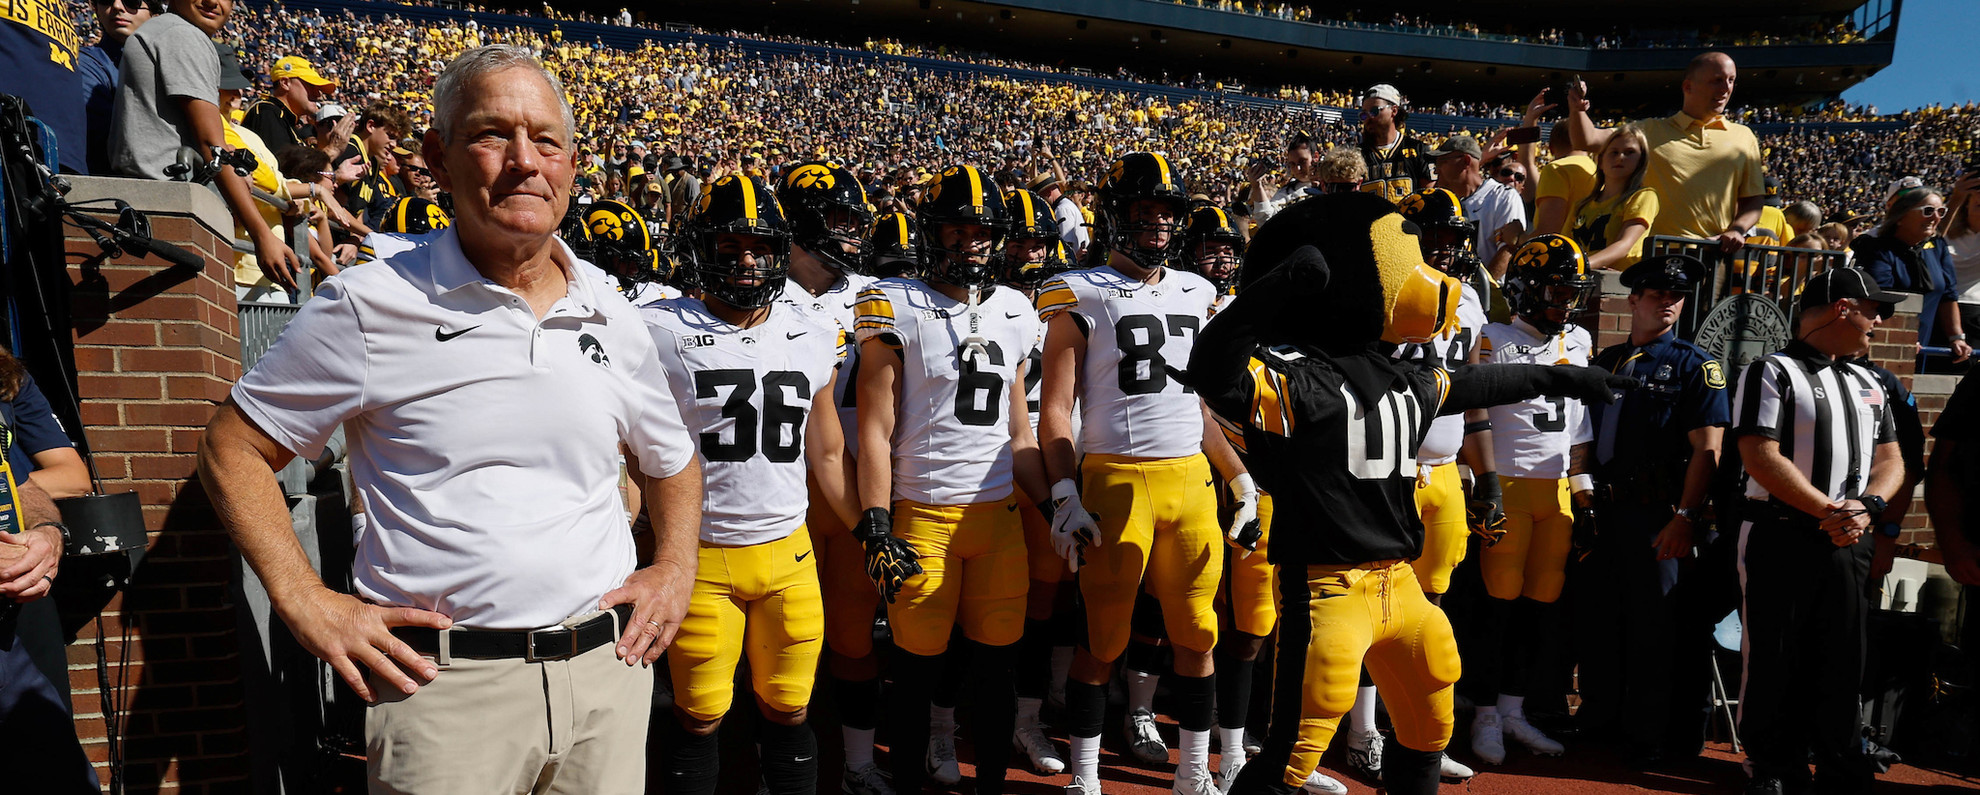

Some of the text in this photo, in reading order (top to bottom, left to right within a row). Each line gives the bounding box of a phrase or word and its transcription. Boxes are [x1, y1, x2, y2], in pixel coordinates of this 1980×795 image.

[36, 5, 79, 59] EARNE
[694, 368, 811, 463] 36
[954, 340, 1005, 426] 6
[1813, 386, 1825, 399] S
